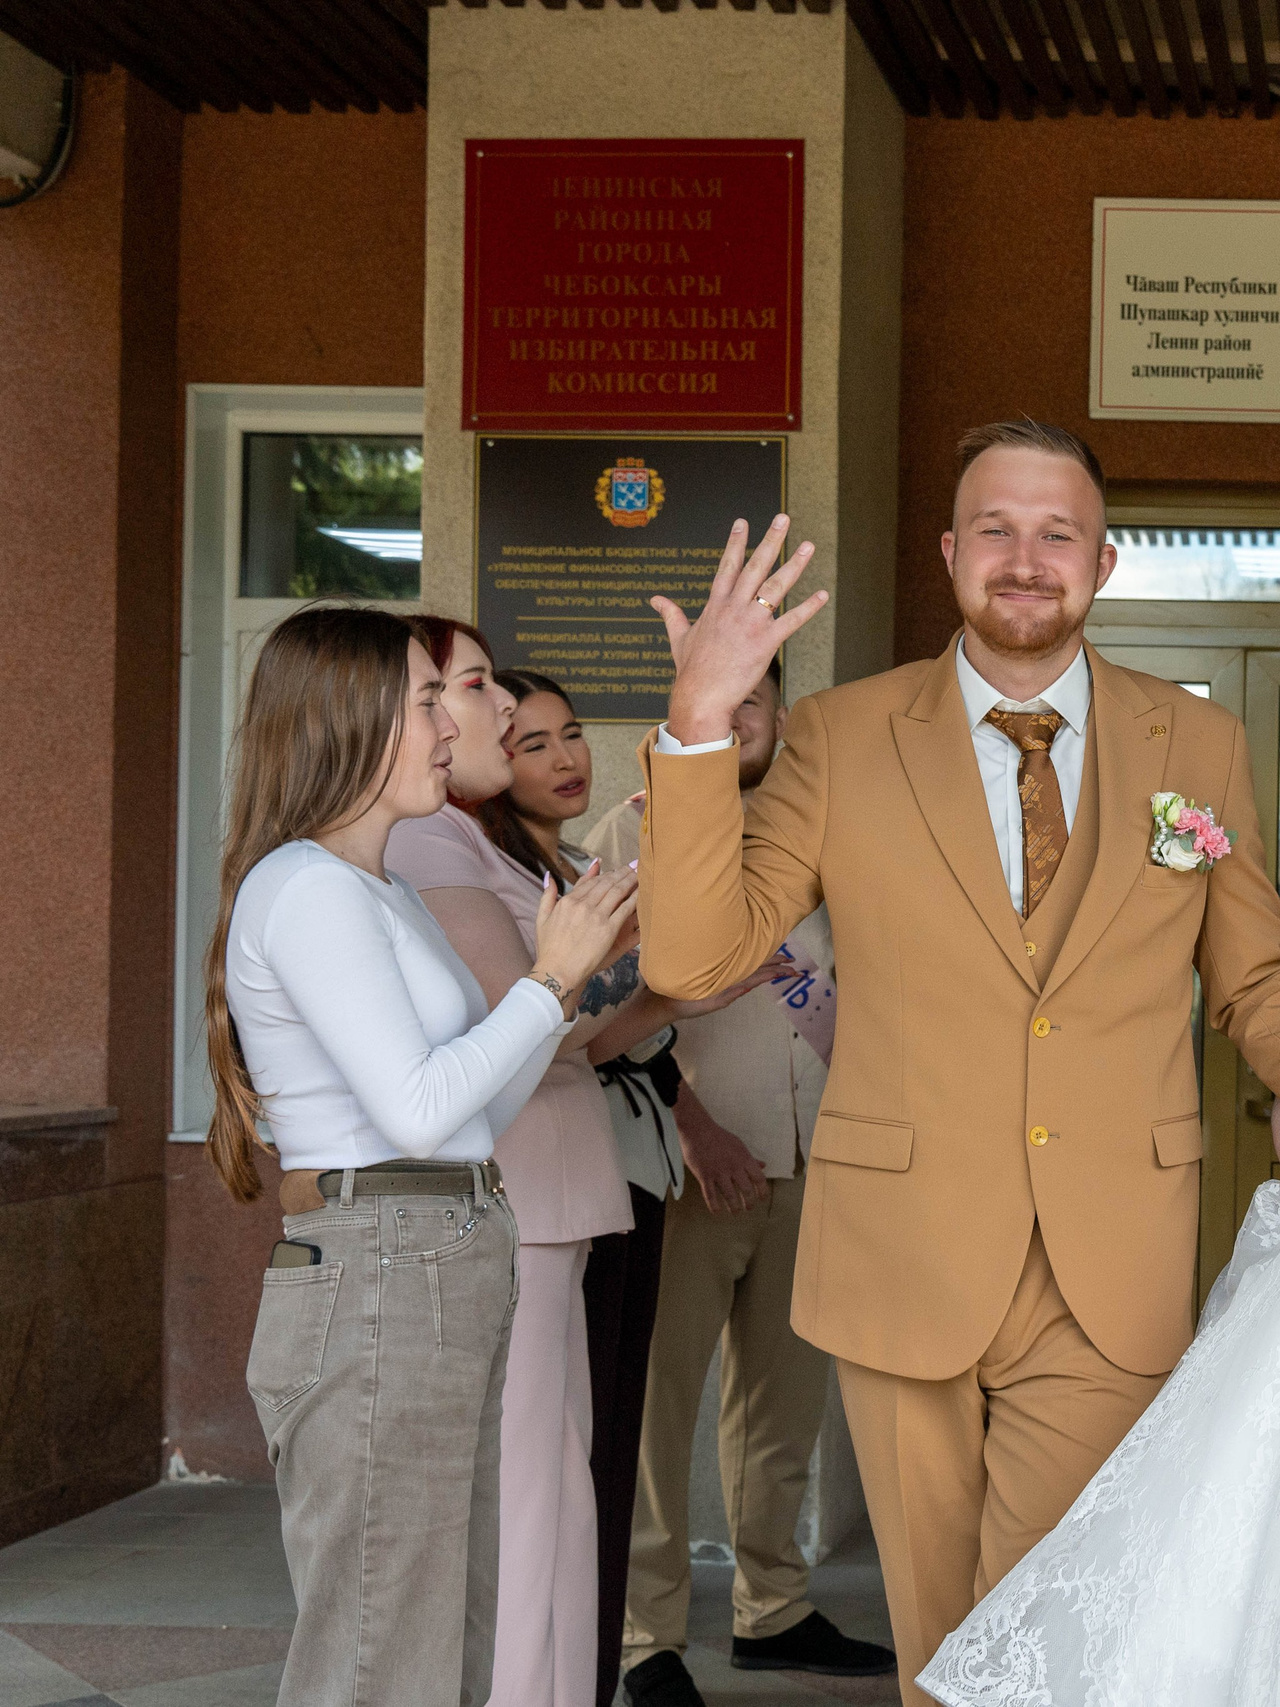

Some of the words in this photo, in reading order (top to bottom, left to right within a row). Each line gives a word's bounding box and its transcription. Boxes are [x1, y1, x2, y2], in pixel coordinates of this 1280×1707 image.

[554, 204, 712, 230] РАЙОННАЯ
[577, 241, 690, 264] ГОРОДА
[544, 275, 722, 296] ЧЕБОКСАРЫ
[1184, 276, 1278, 303] Республики
[488, 306, 778, 329] ТЕРРИТОРИАЛЬНАЯ
[1120, 303, 1210, 326] Шупашкар
[1214, 308, 1280, 326] хулинчи
[508, 340, 757, 362] ИЗБИРАТЕЛЬНАЯ
[1147, 332, 1200, 351] Ленин
[1204, 333, 1252, 357] район
[547, 372, 719, 394] КОМИССИЯ
[502, 546, 602, 557] МУНИЦИПАЛЬНОЕ
[605, 547, 678, 558] БЮДЖЕТНОЕ
[495, 579, 579, 589] ОБЕСПЕЧЕНИЯ
[581, 580, 684, 591] МУНИЦИПАЛЬНЫХ
[536, 596, 595, 607] КУЛЬТУРЫ
[597, 597, 643, 608] ГОРОДА
[604, 633, 653, 644] БЮДЖЕТ
[602, 650, 640, 661] ХУЛИН
